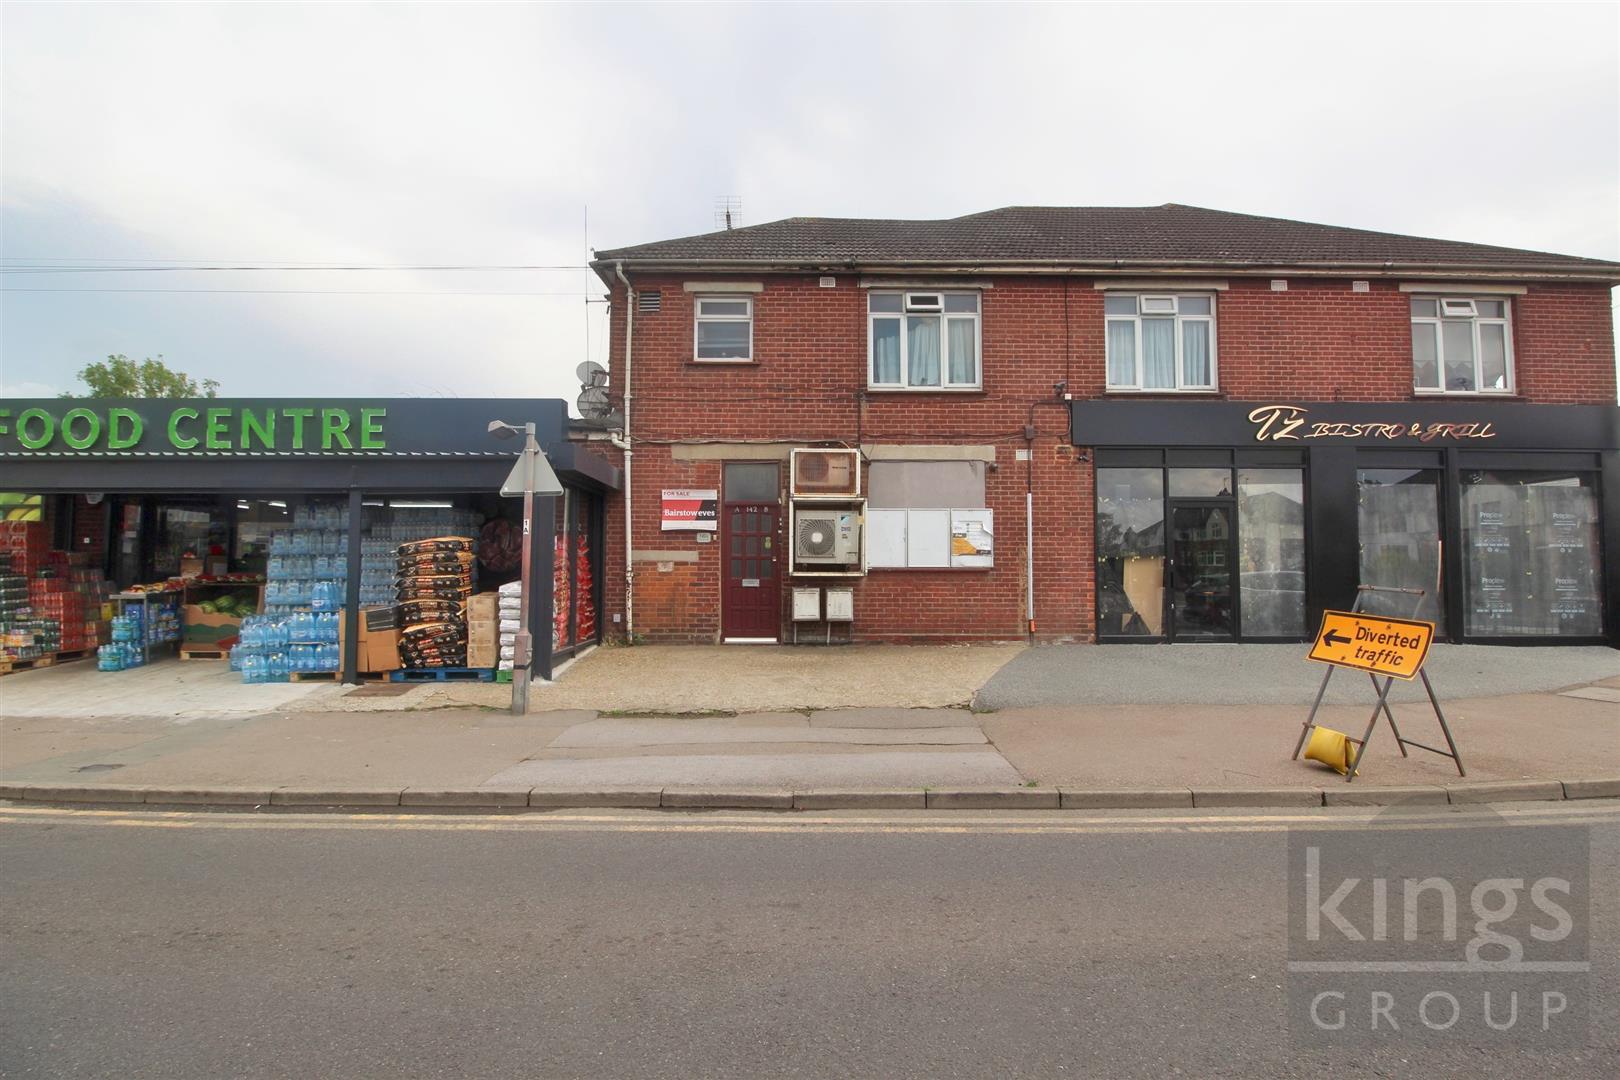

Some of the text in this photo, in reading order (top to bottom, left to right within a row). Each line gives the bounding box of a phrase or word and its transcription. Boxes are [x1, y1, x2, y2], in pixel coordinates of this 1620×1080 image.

[167, 407, 387, 449] CENTRE
[1304, 423, 1406, 438] BISTRO
[1407, 423, 1422, 437] &
[1420, 423, 1496, 442] GRILL
[1355, 626, 1421, 650] Diverted
[1354, 645, 1404, 666] traffic
